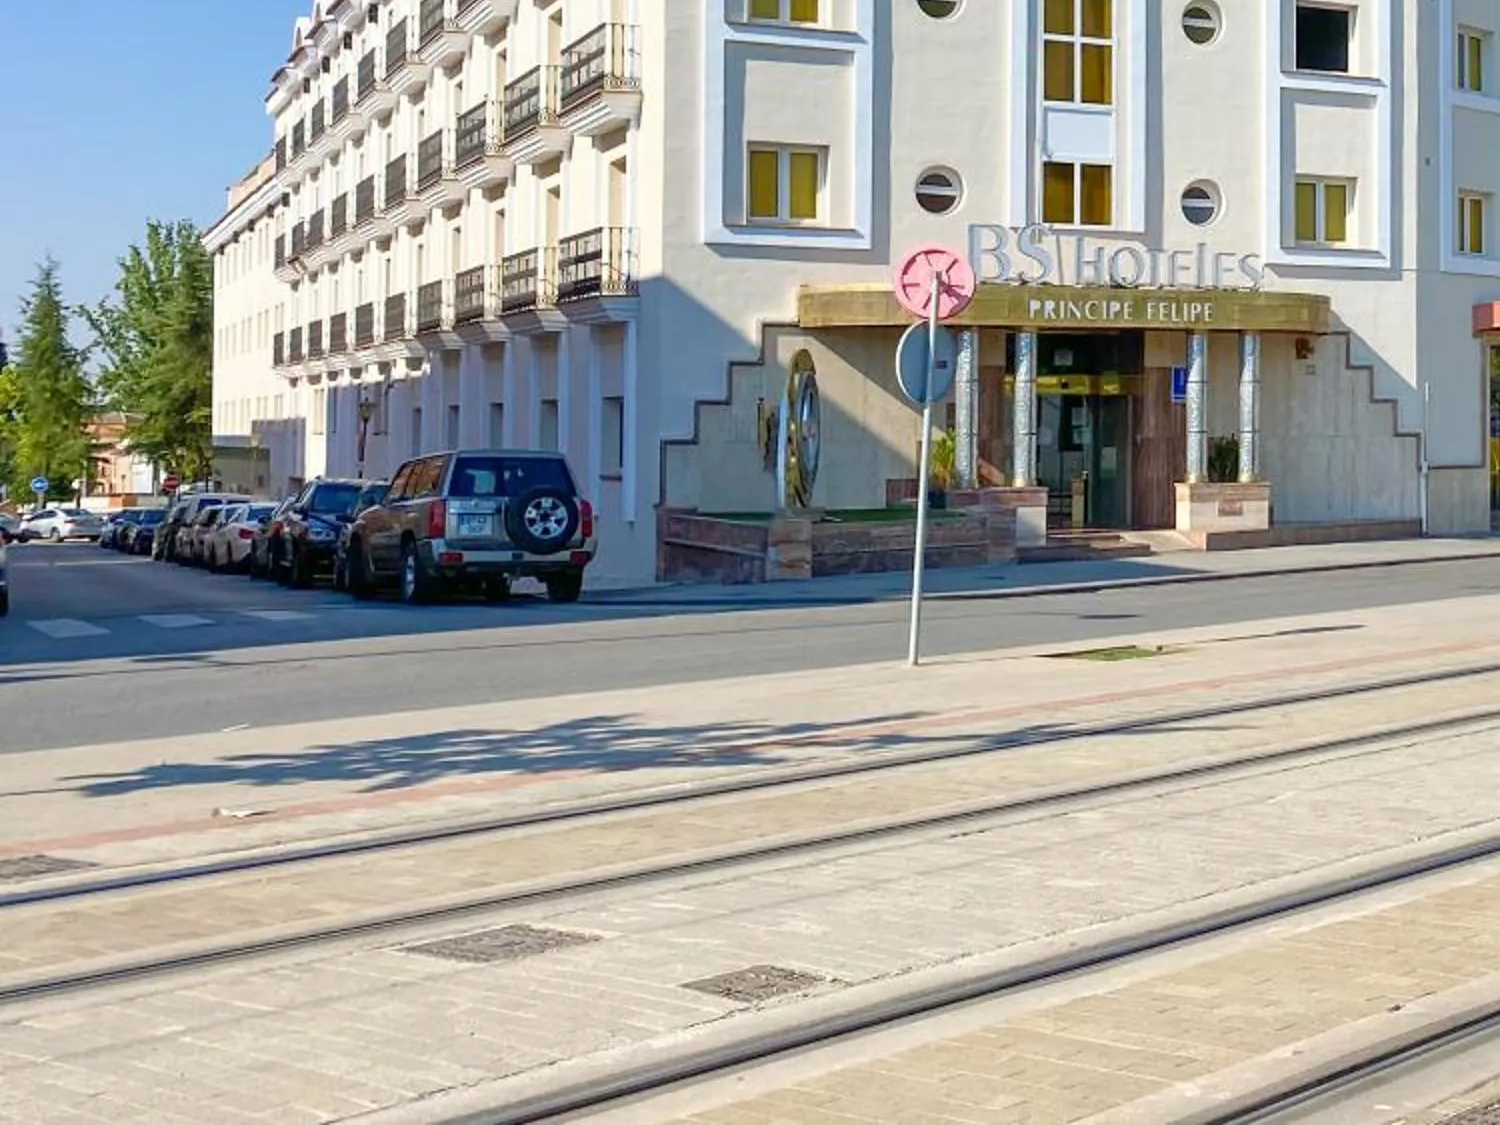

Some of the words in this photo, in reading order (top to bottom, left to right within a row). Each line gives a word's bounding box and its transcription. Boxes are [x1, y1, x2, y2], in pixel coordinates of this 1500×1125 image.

[968, 224, 1052, 283] BS
[1073, 235, 1264, 290] HOTELES
[1028, 299, 1134, 321] PRINCIPE
[1146, 301, 1214, 322] FELIPE
